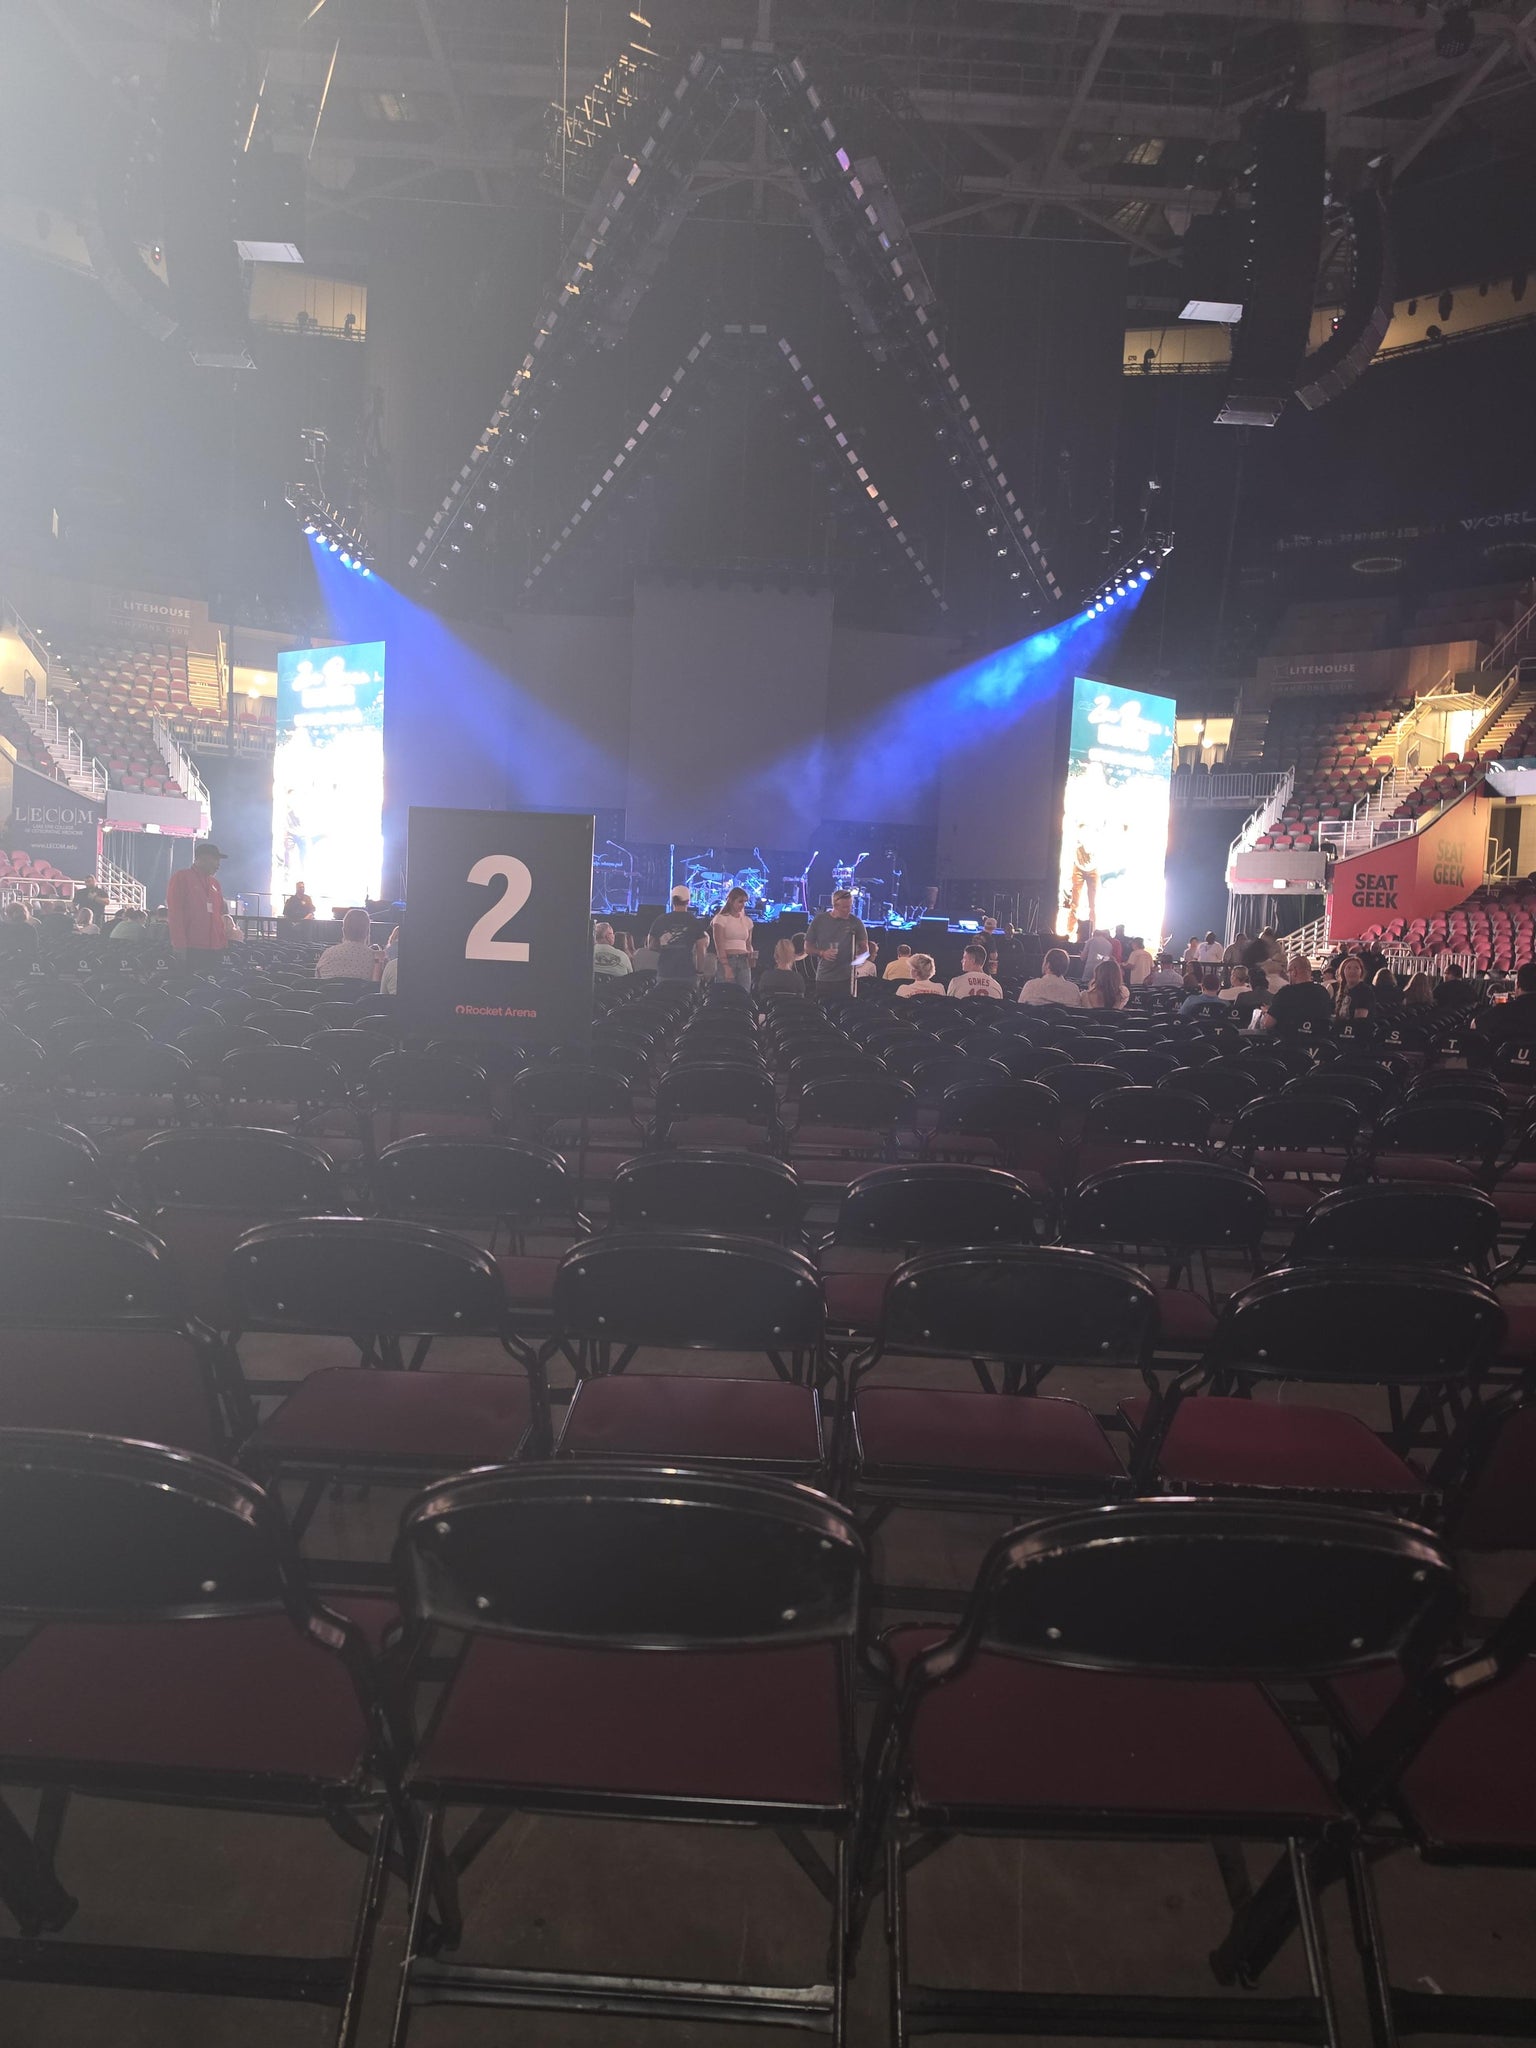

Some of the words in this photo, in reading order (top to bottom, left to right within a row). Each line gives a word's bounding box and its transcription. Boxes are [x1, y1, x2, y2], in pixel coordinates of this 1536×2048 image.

[123, 600, 191, 619] LITEHOUSE
[1289, 663, 1356, 675] LITEHOUSE
[1437, 839, 1465, 862] SEAT
[1433, 863, 1465, 888] GEEK
[1355, 873, 1398, 891] SEAT
[1351, 891, 1398, 910] GEEK
[465, 854, 532, 962] 2
[32, 962, 40, 971] R
[967, 977, 990, 987] GOMES
[466, 1005, 502, 1017] Rocket
[505, 1007, 537, 1018] Arena
[1303, 1021, 1312, 1030] Q
[1344, 1025, 1353, 1034] R
[1390, 1030, 1400, 1040] S
[1449, 1039, 1458, 1049] T
[1518, 1048, 1530, 1060] U
